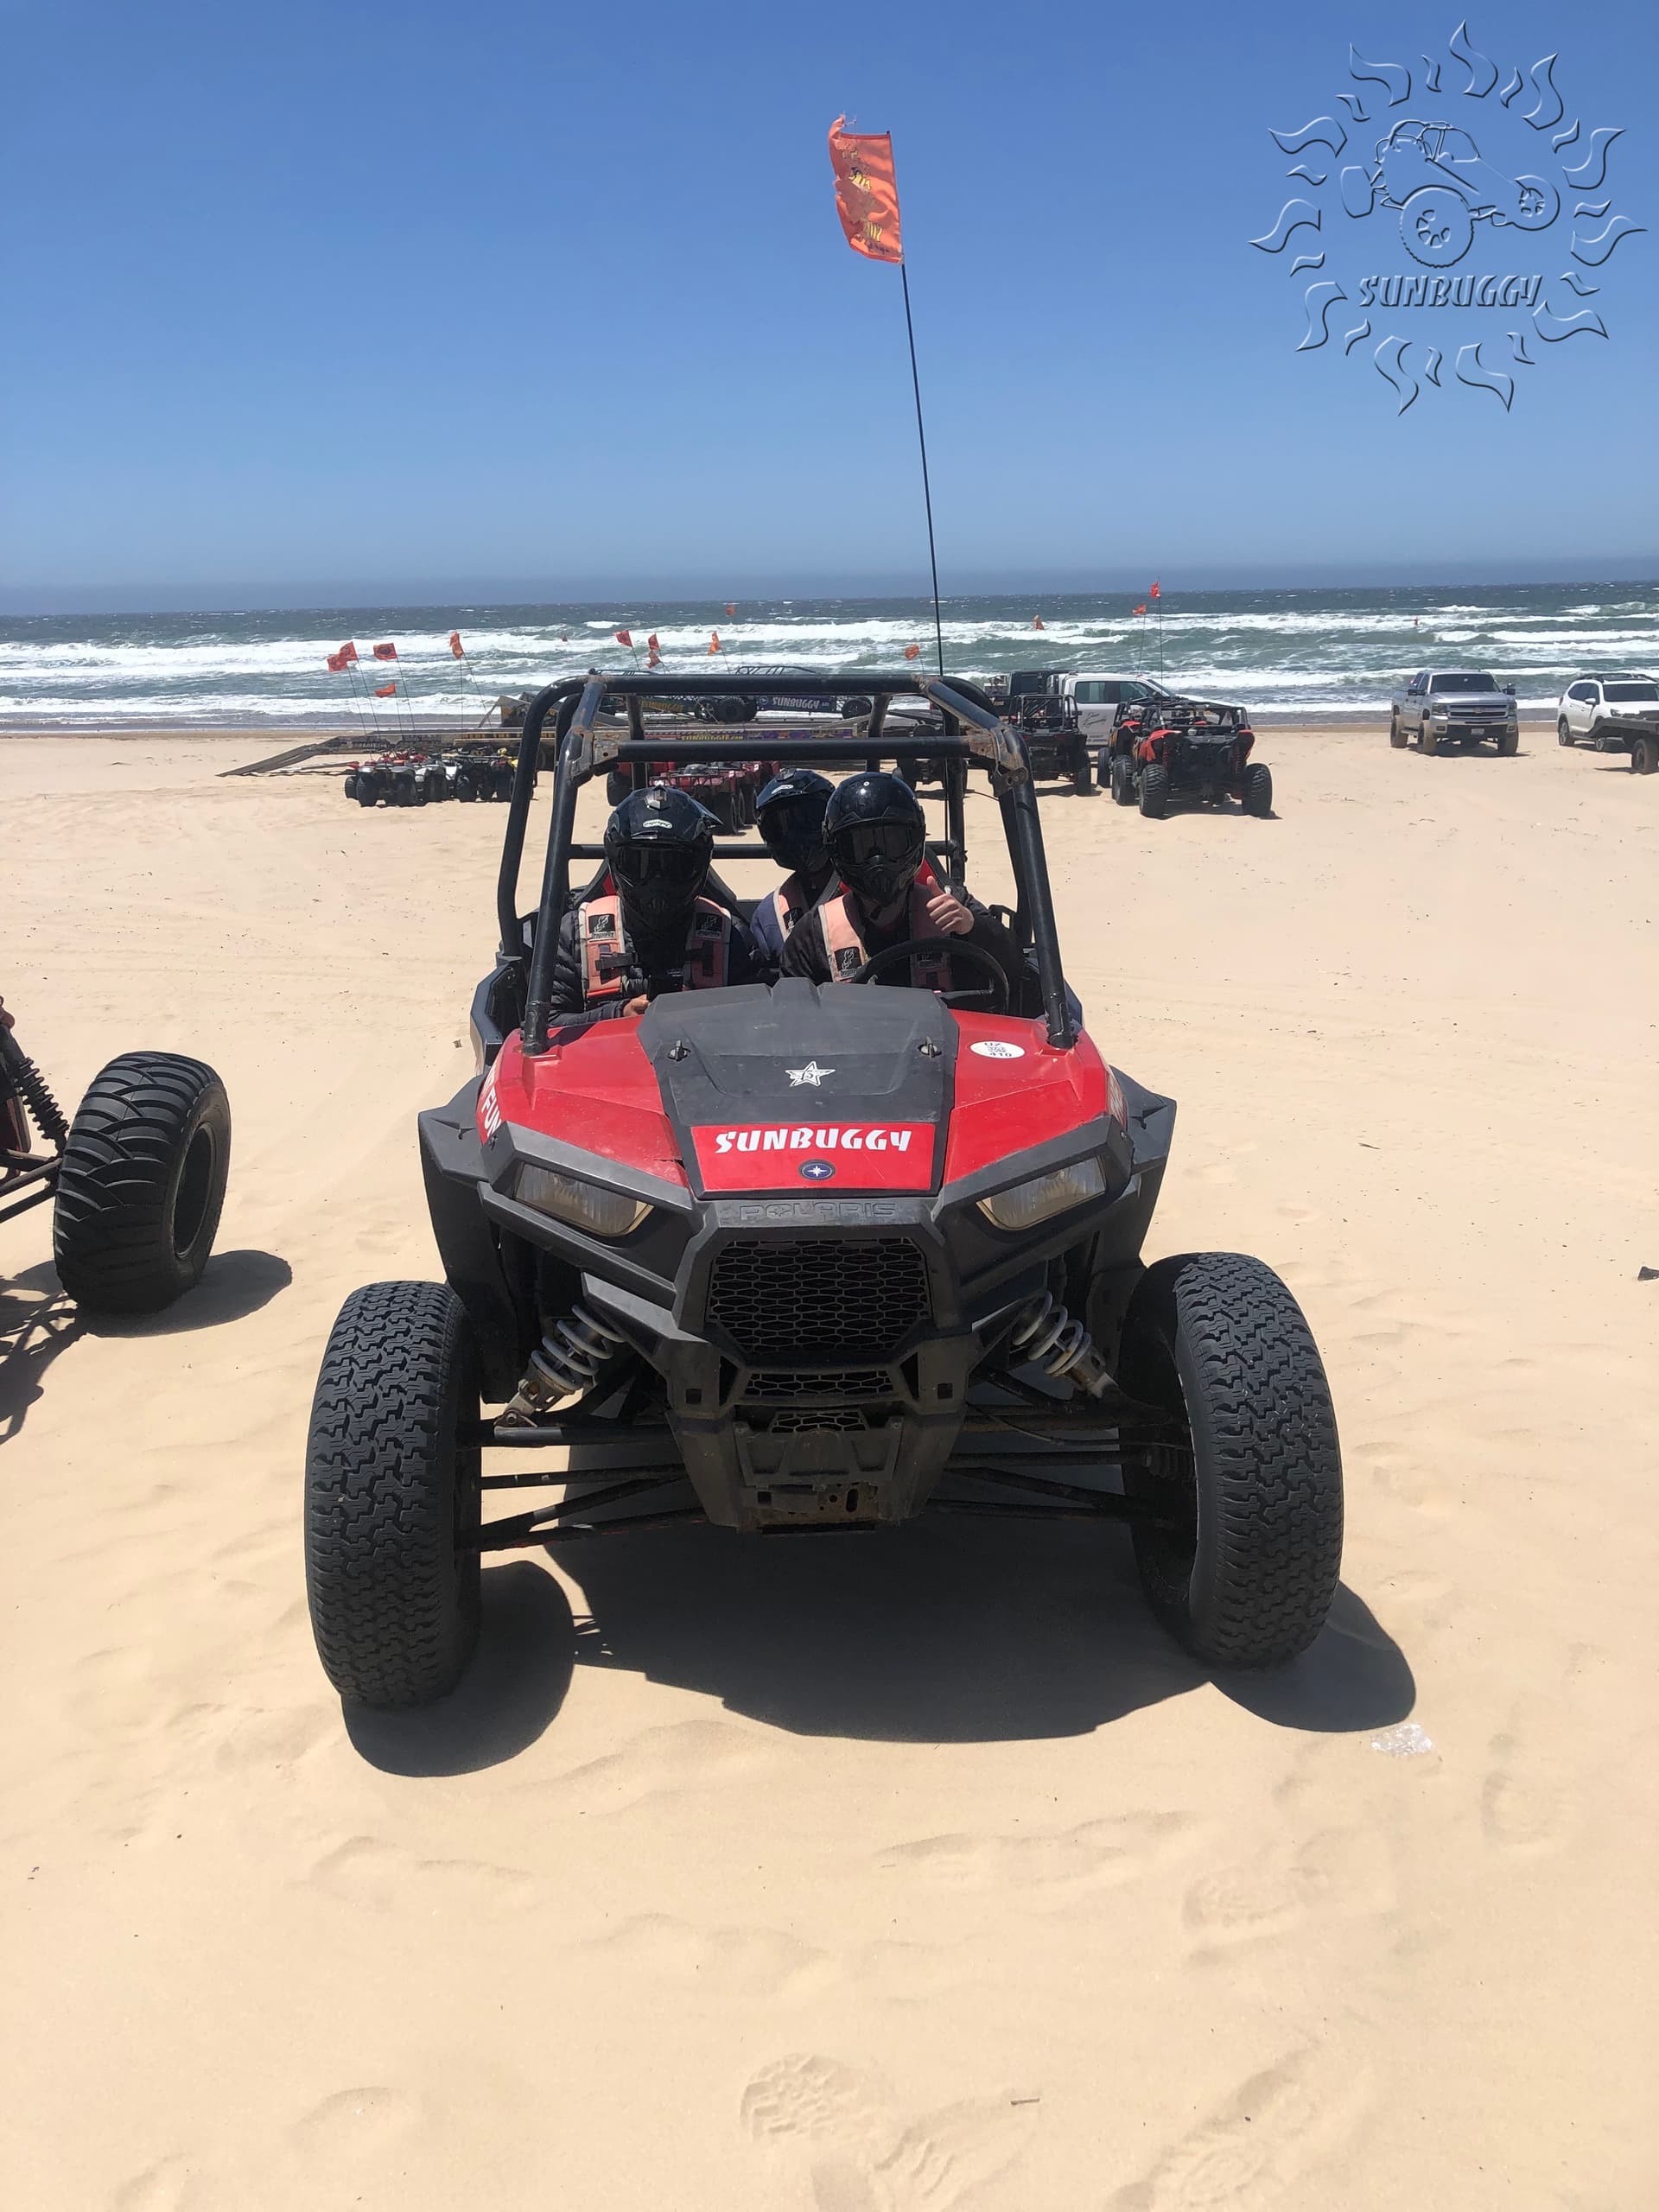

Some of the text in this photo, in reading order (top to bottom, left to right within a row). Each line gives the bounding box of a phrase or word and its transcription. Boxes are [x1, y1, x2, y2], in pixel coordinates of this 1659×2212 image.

[772, 696, 820, 709] SUNBUGGY
[715, 1127, 912, 1154] SUNBUGGY
[739, 1202, 896, 1221] POLARIS
